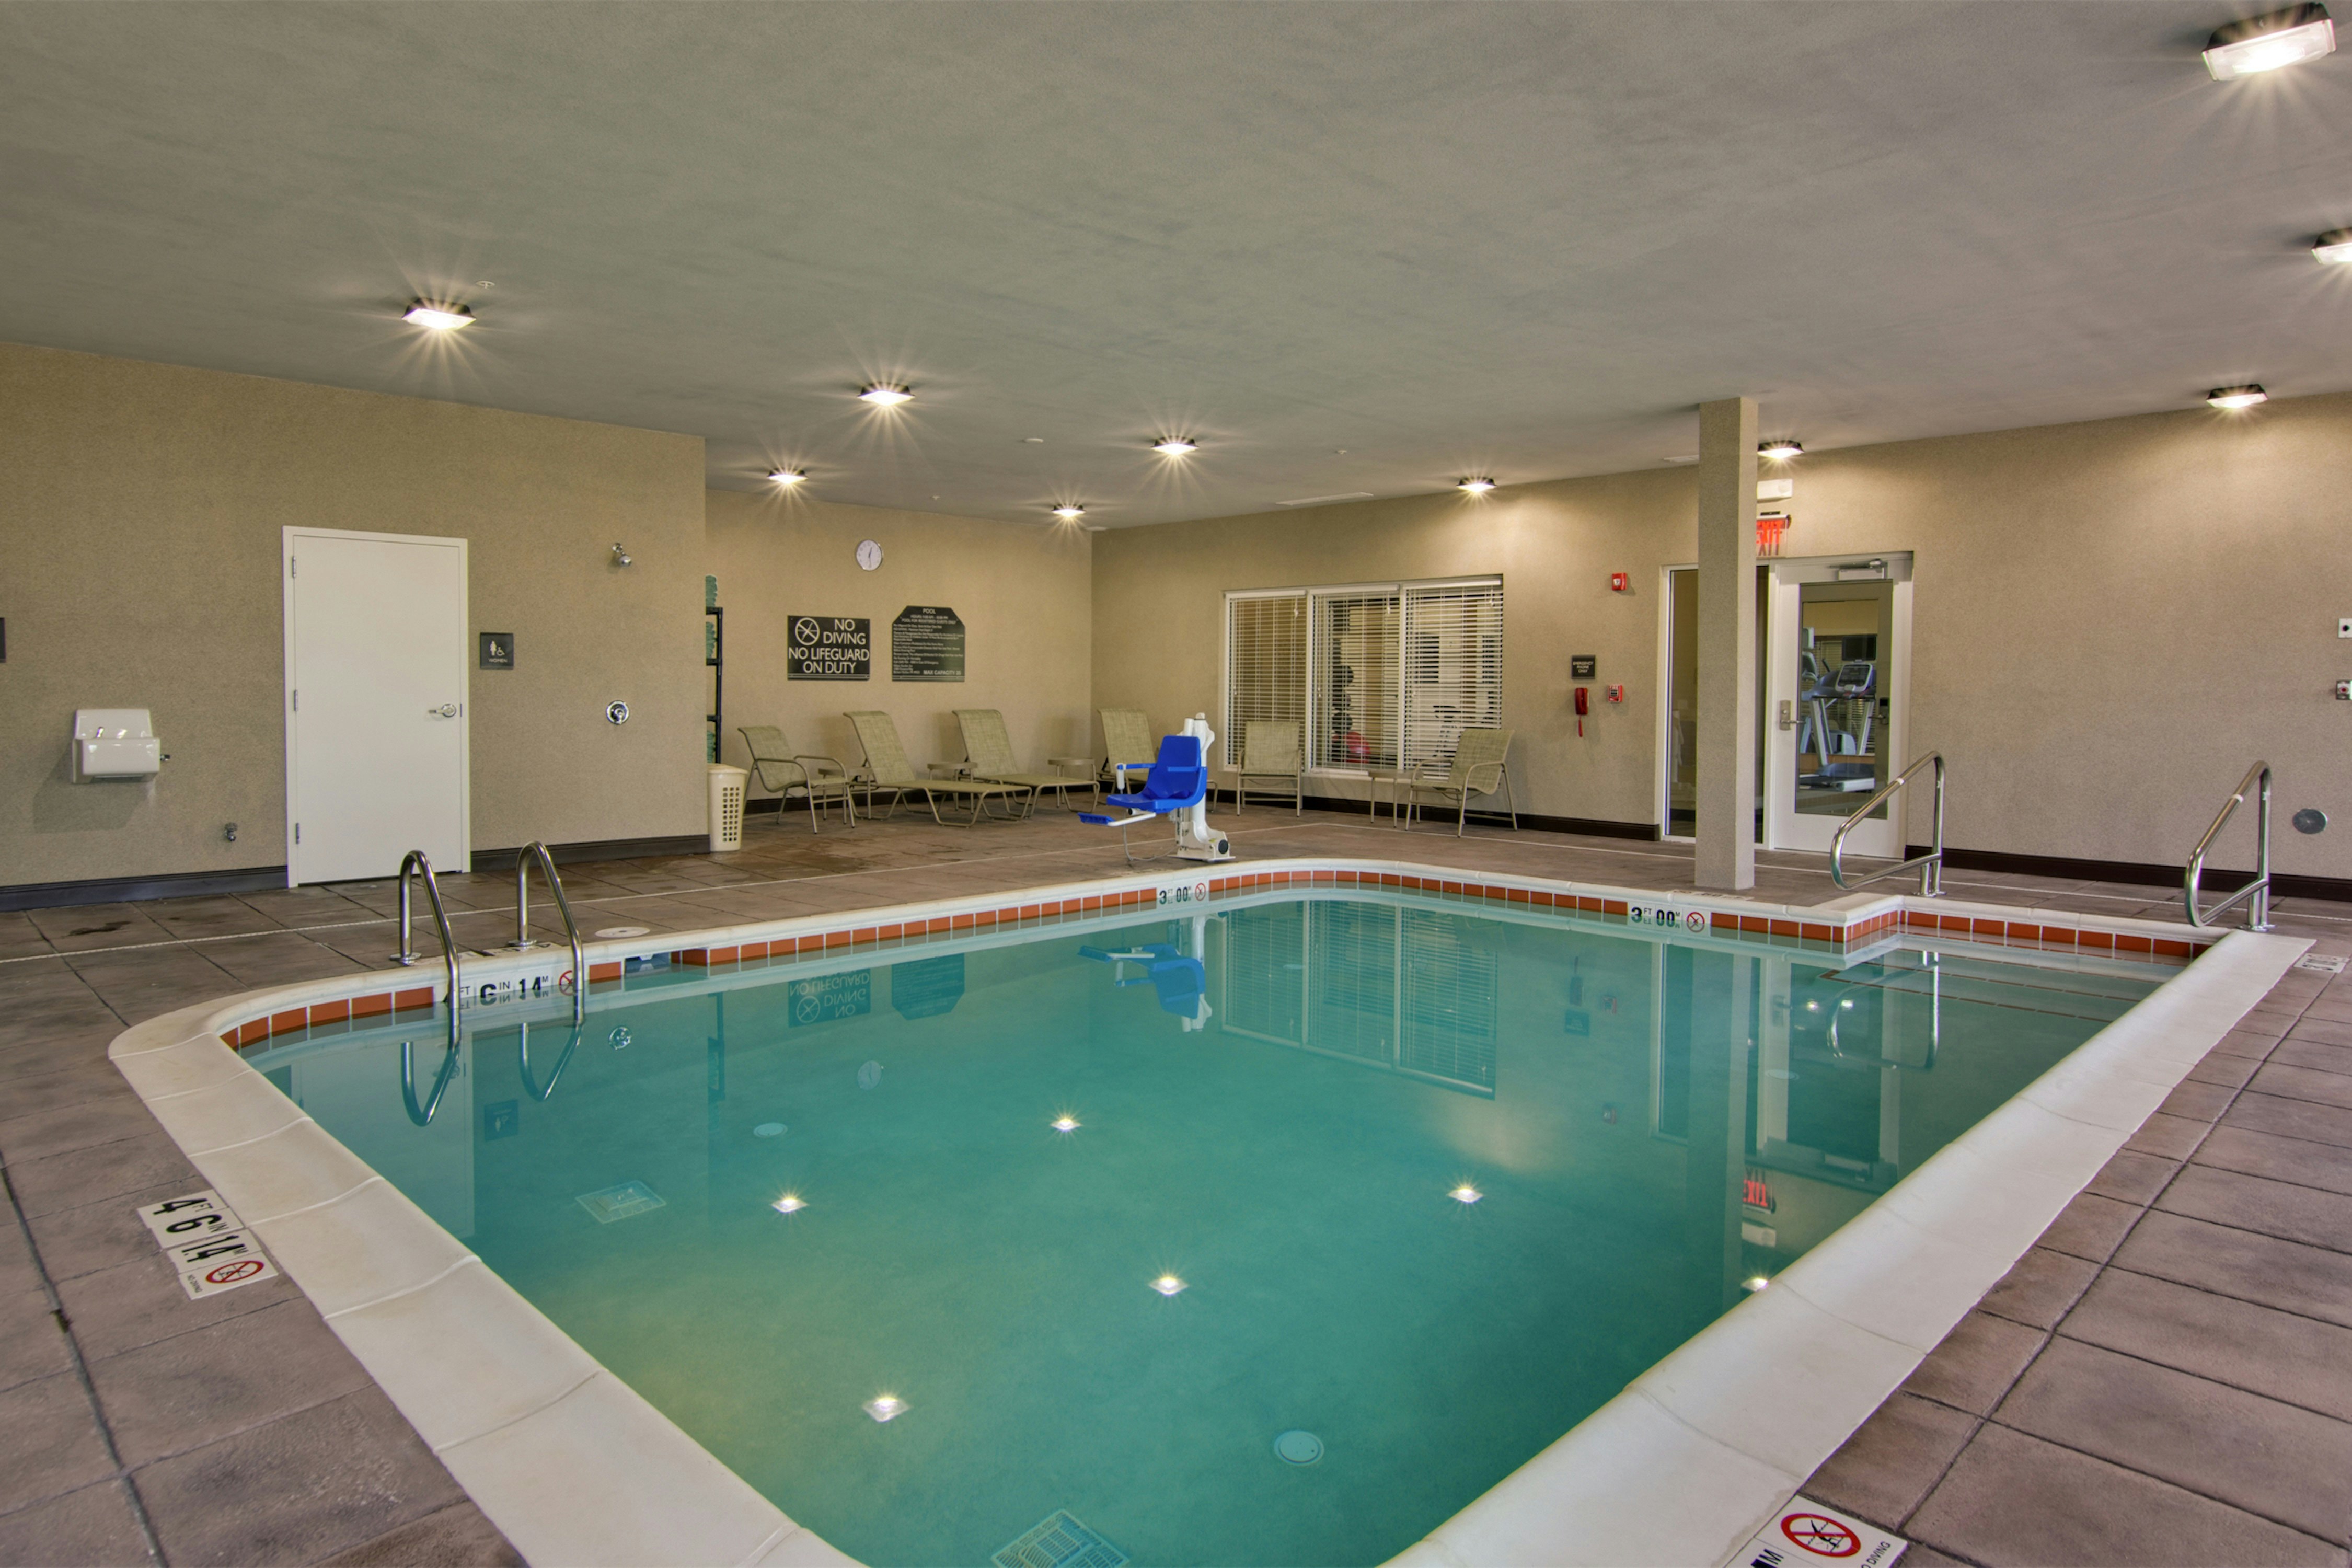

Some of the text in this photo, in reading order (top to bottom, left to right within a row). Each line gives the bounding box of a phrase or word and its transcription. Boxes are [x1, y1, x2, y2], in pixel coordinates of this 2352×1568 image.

[834, 619, 855, 631] NO
[823, 630, 866, 645] DIVING
[788, 647, 870, 661] NO LIFEGUARD
[803, 661, 856, 674] ON DUTY
[1160, 890, 1167, 904] 3
[1631, 907, 1642, 923] 3
[499, 981, 510, 990] IN
[153, 1198, 208, 1215] 4
[192, 1203, 213, 1212] FT
[166, 1214, 222, 1233] 6
[1758, 1549, 1784, 1565] M
[1866, 1541, 1890, 1565] DIVING
